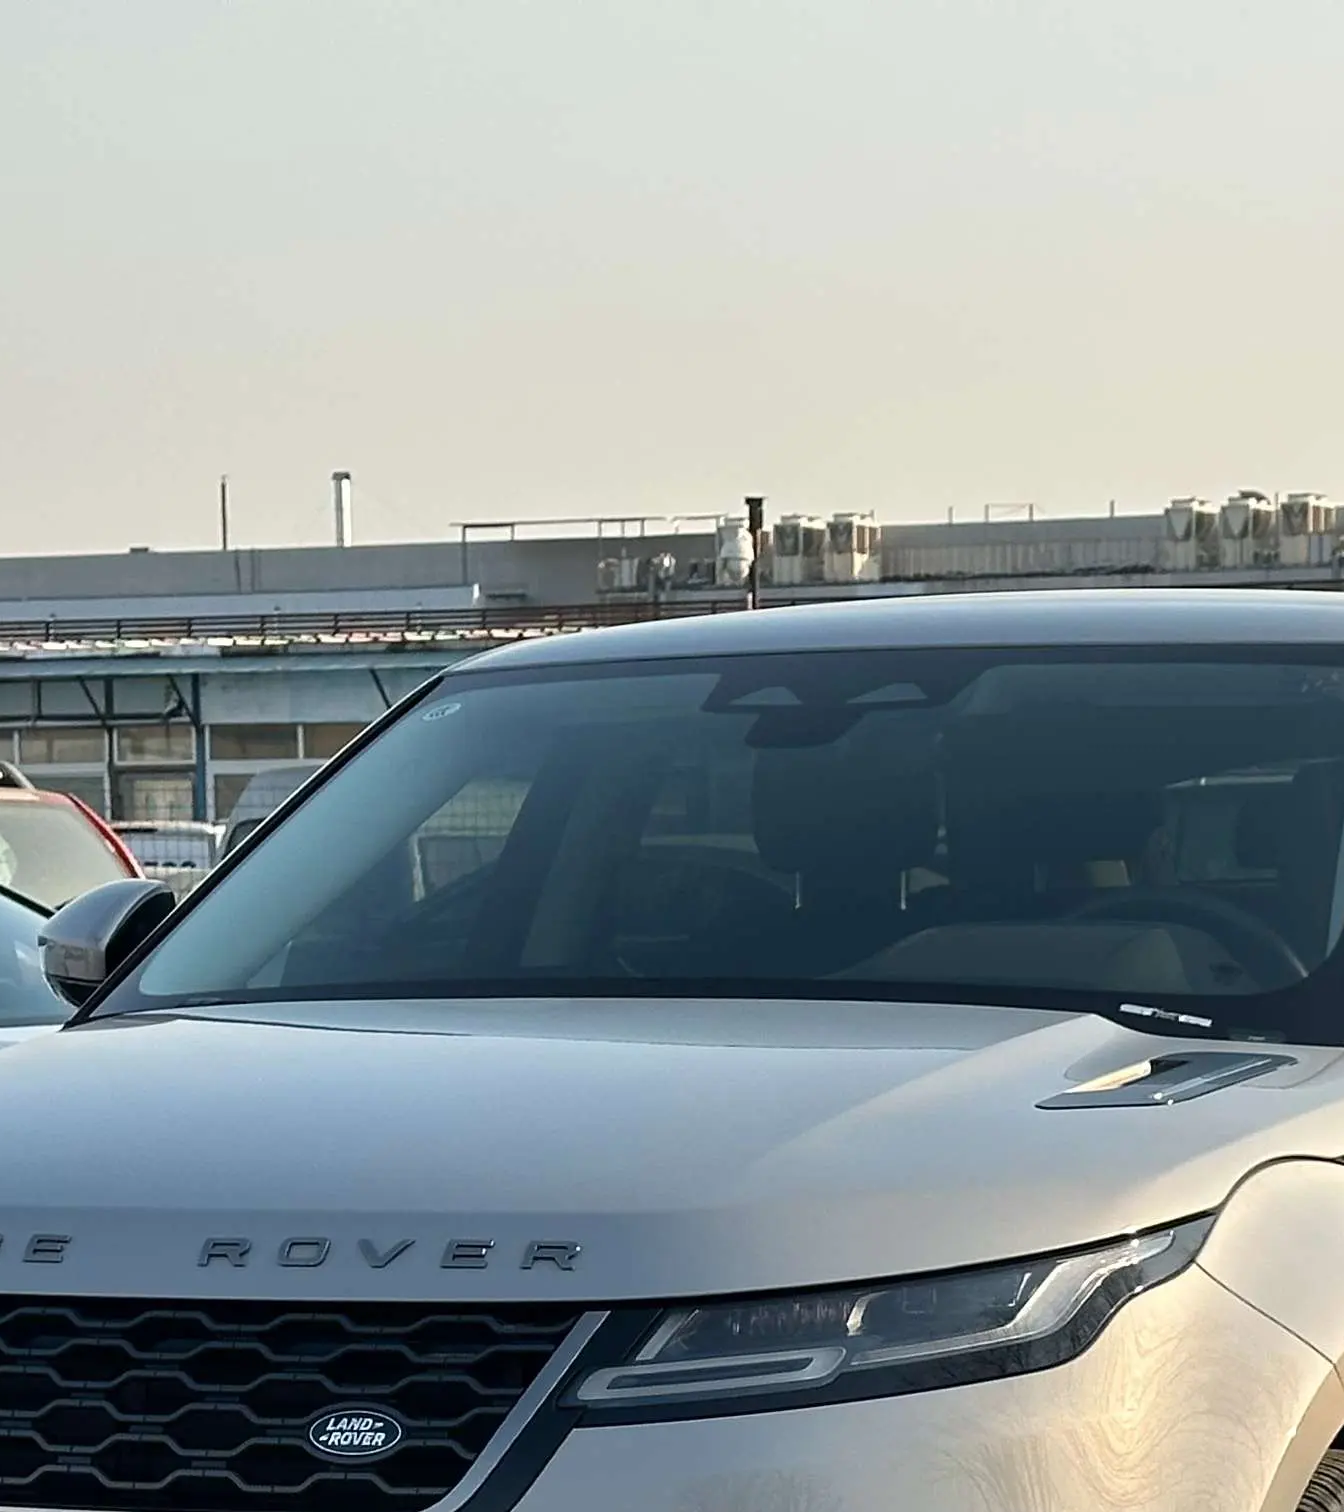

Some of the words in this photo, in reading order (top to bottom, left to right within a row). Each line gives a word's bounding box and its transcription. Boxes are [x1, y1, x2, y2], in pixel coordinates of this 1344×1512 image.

[198, 1234, 583, 1270] ROVER
[326, 1417, 374, 1431] LAND
[328, 1432, 386, 1446] ROVER
